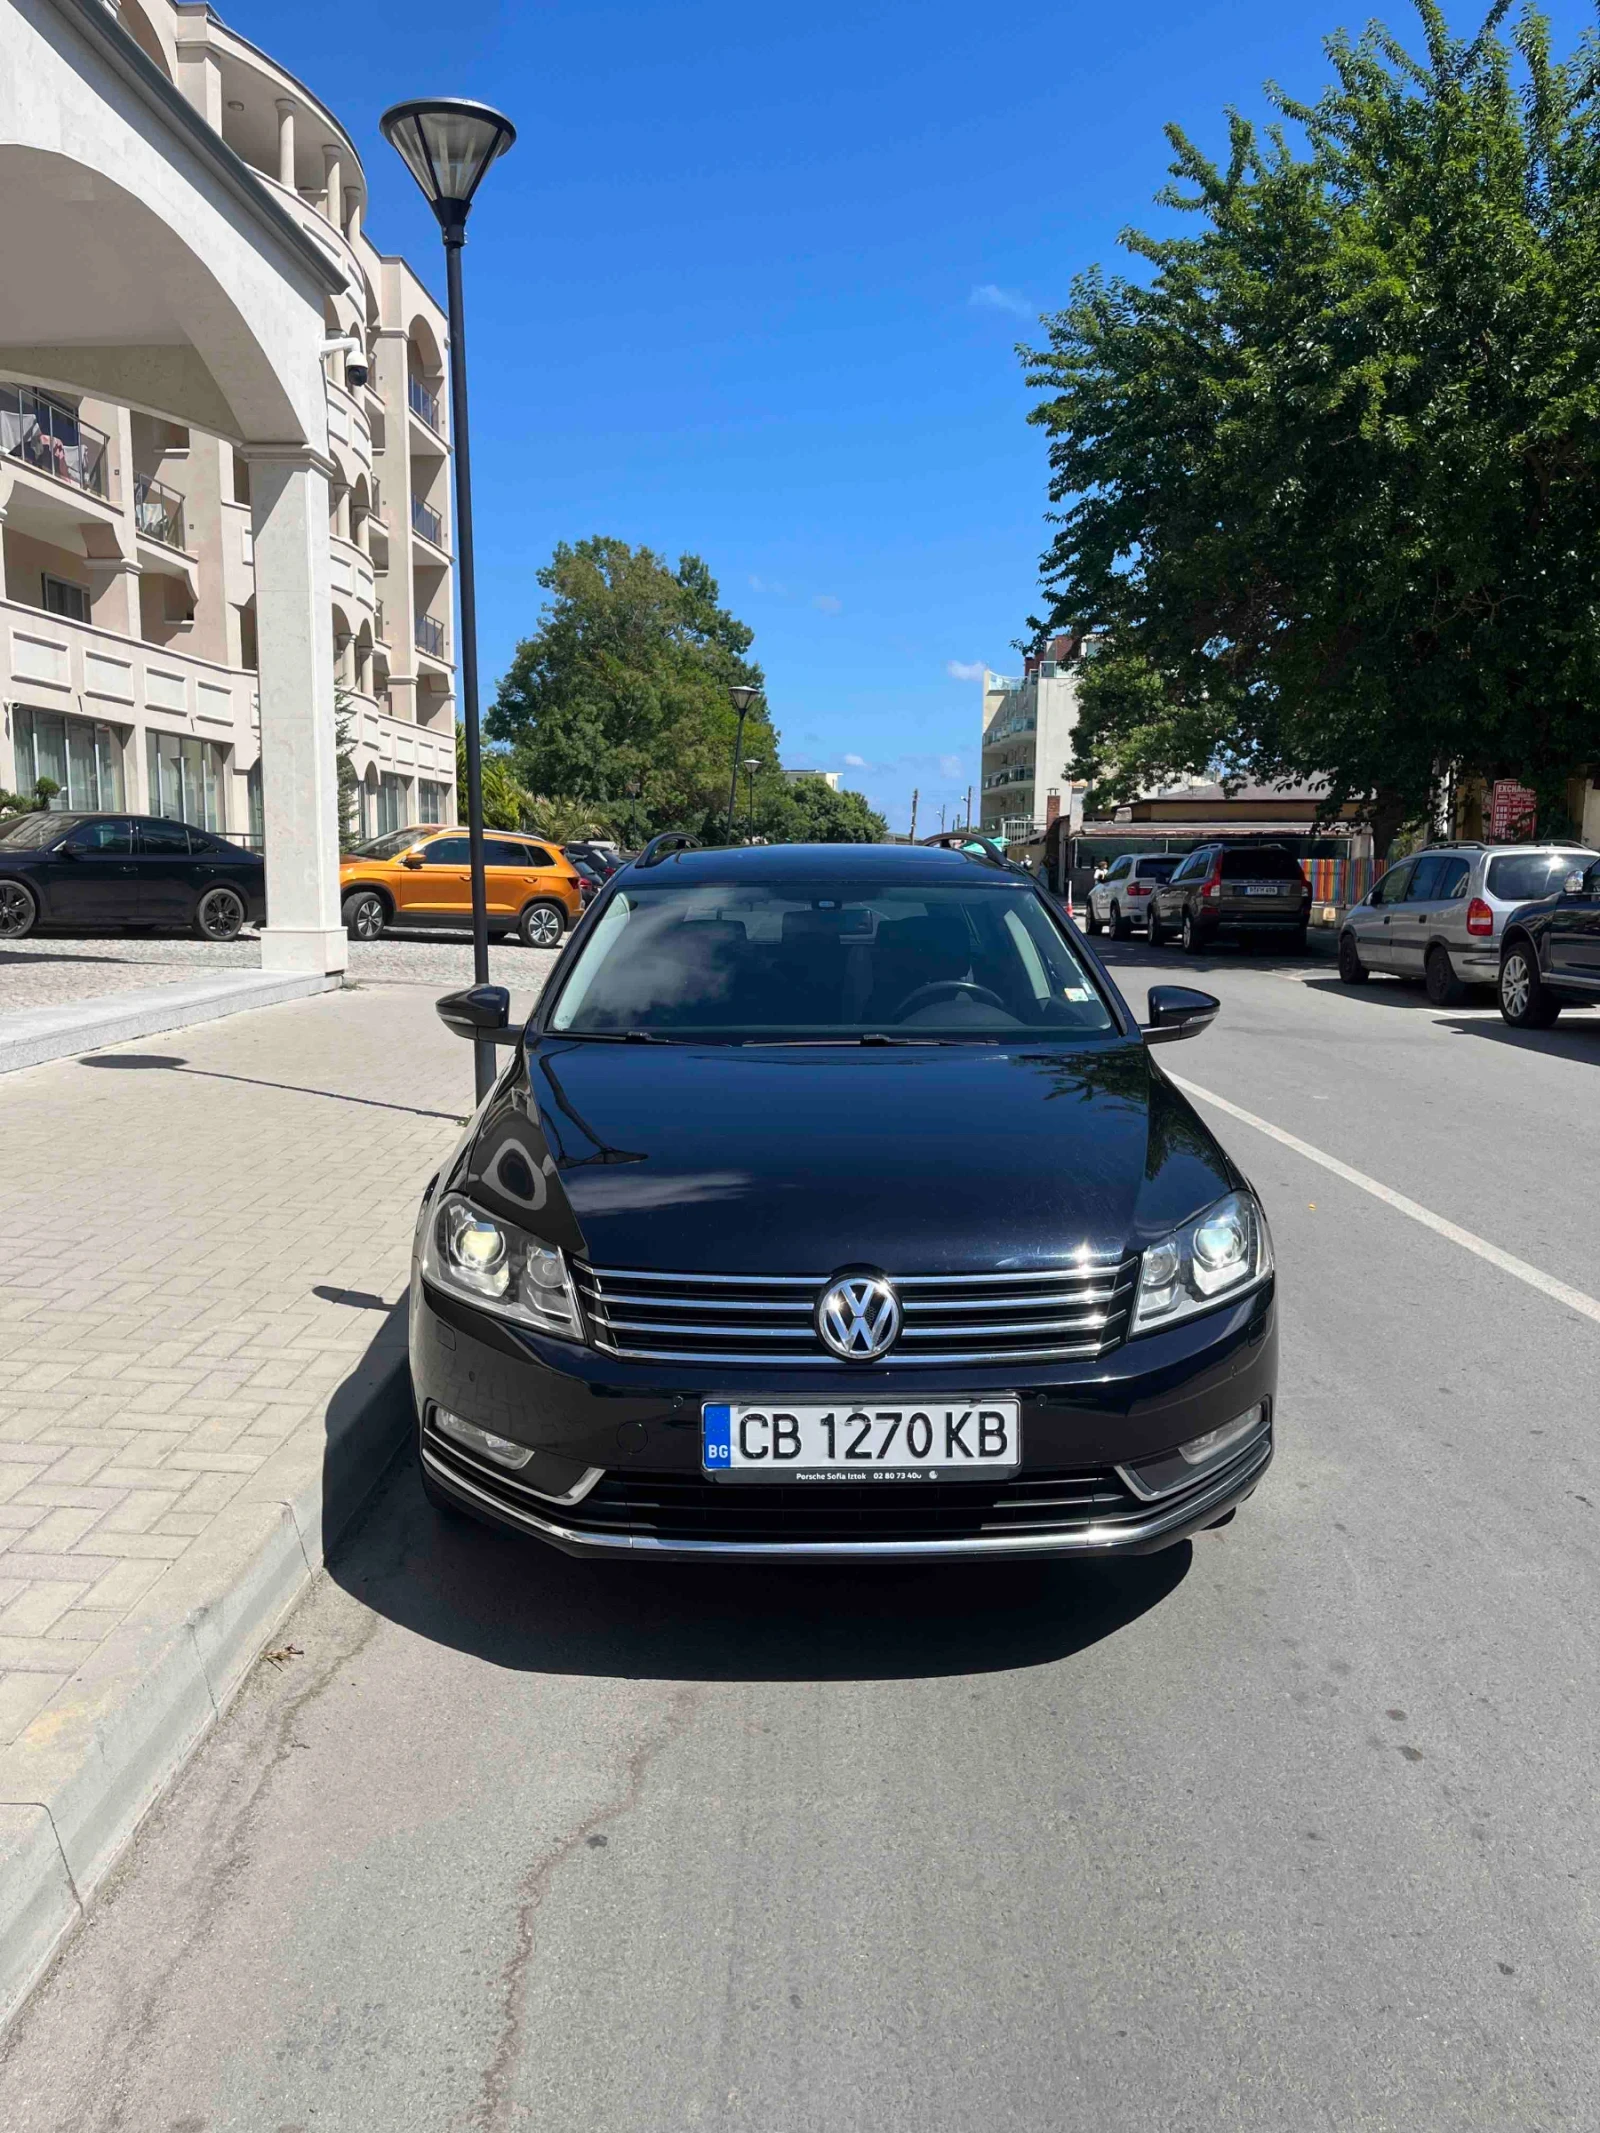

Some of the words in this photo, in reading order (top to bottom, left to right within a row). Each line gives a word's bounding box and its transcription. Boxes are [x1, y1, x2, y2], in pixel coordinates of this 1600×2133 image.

[1498, 784, 1536, 793] EXCHA
[822, 1279, 897, 1357] VW
[739, 1412, 802, 1460] CB
[820, 1412, 933, 1460] 1270
[945, 1411, 1008, 1459] KB
[708, 1444, 729, 1460] BG
[796, 1472, 826, 1480] Porsche
[826, 1472, 847, 1480] Sofia
[847, 1472, 867, 1480] Iztok
[873, 1472, 884, 1480] 02
[884, 1472, 895, 1480] 80
[896, 1472, 906, 1480] 73
